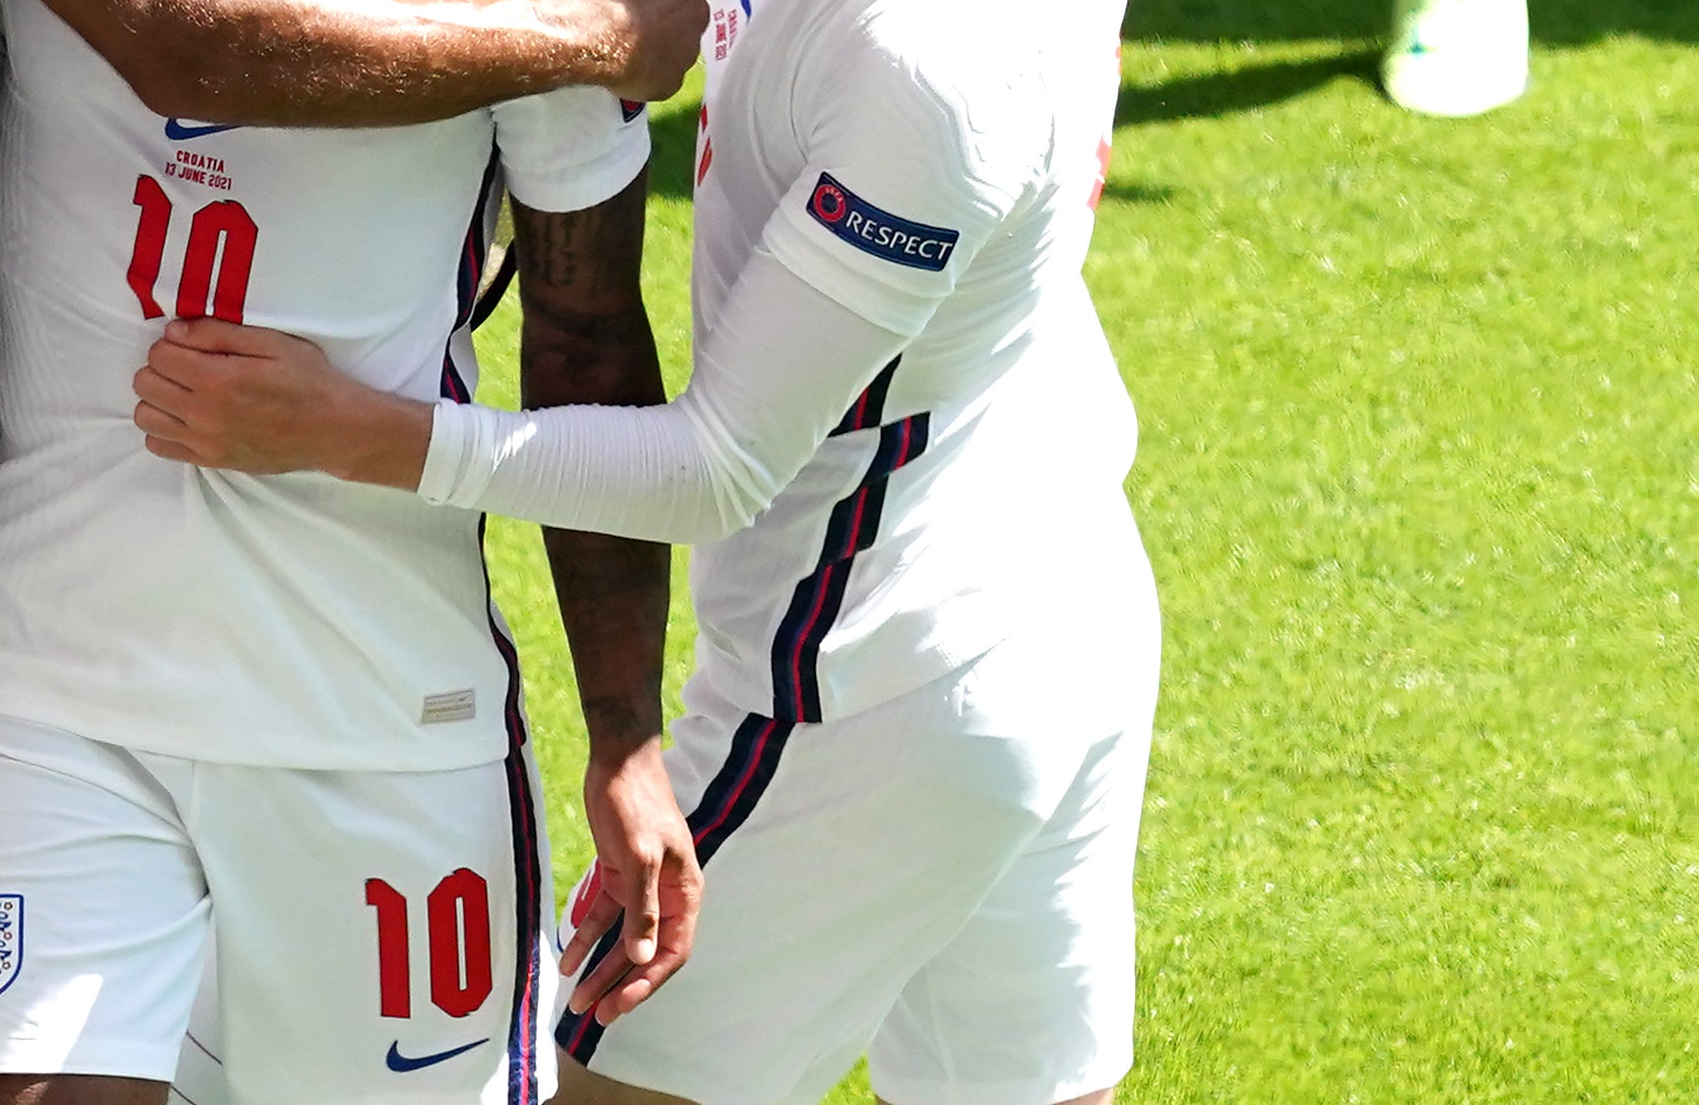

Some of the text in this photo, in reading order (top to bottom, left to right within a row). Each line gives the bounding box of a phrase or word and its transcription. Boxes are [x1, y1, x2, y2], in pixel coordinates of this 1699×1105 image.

[165, 162, 232, 190] 13 JUNE 2021
[176, 150, 224, 173] CROATIA
[126, 174, 259, 325] 10
[846, 211, 953, 261] RESPECT
[365, 867, 493, 1019] 10
